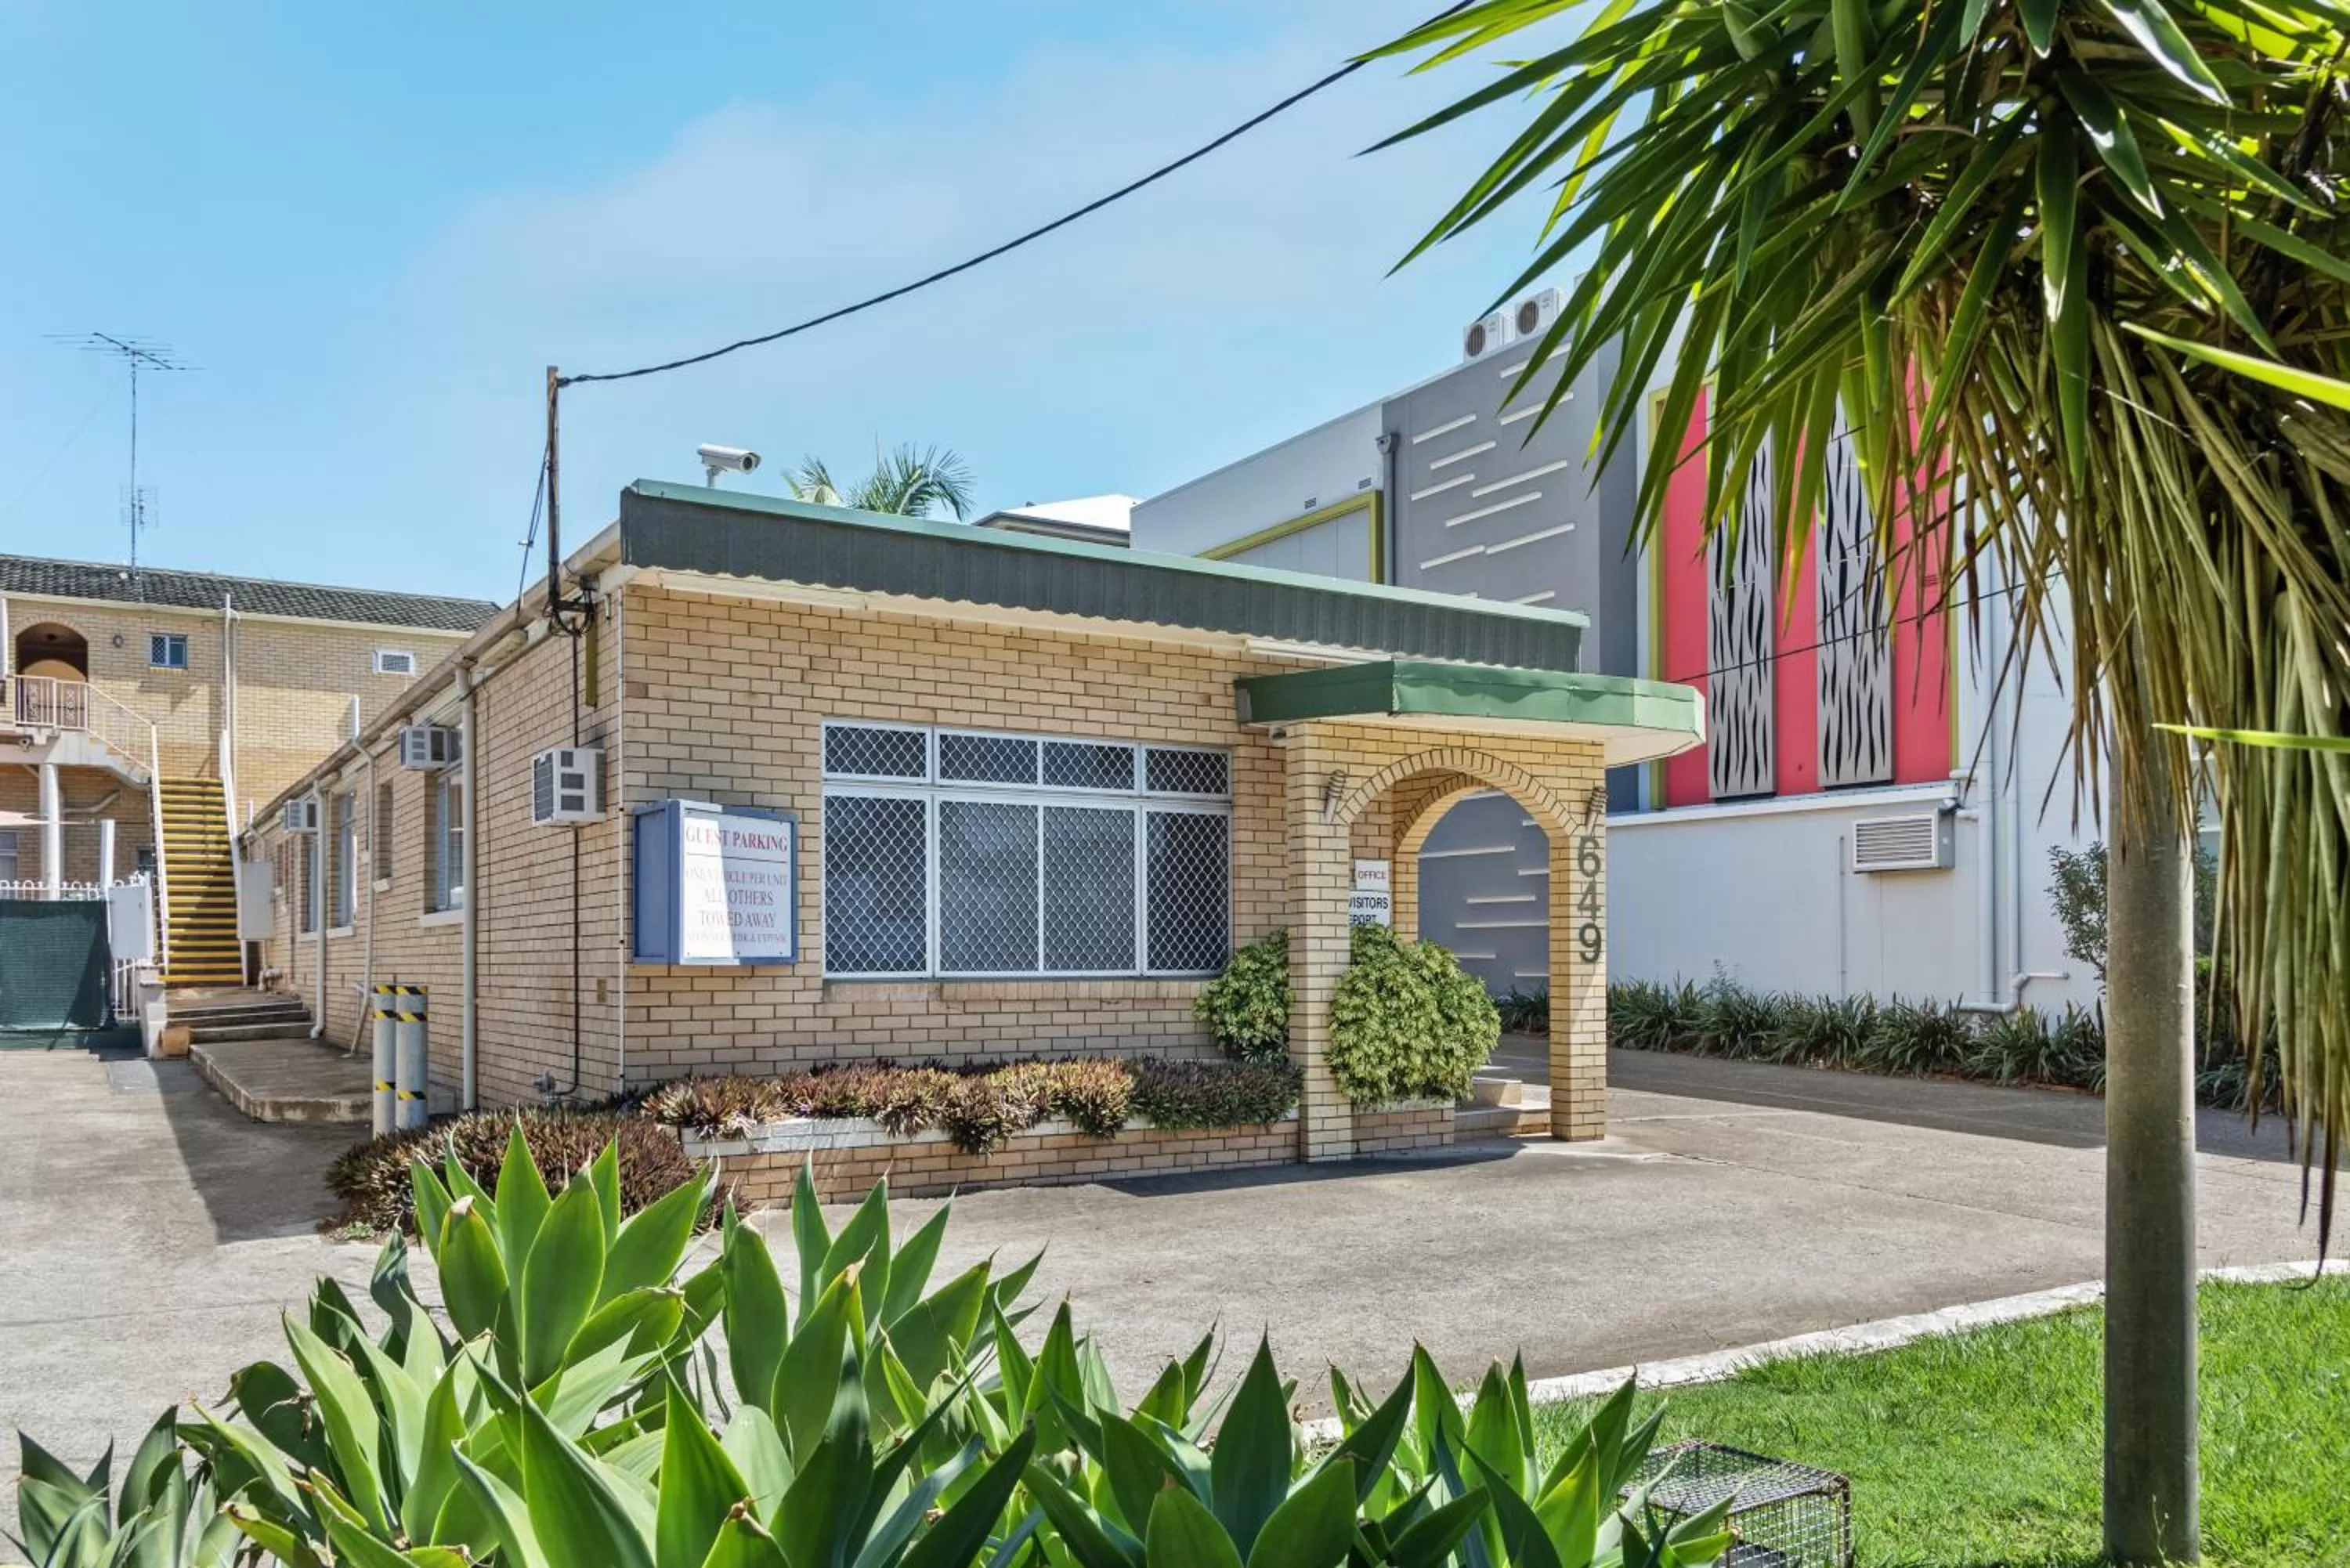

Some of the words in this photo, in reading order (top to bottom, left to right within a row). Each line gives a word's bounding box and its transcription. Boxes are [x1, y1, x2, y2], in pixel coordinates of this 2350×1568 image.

[686, 826, 729, 847] GUEST
[732, 830, 787, 852] PARKING
[767, 873, 787, 887] UNIT
[1358, 870, 1386, 880] OFFICE
[704, 887, 723, 903] ALL
[728, 889, 774, 906] OTHERS
[1578, 835, 1601, 963] 649
[700, 909, 742, 926] TOWED
[745, 912, 776, 927] AWAY
[1349, 914, 1377, 924] EPORT
